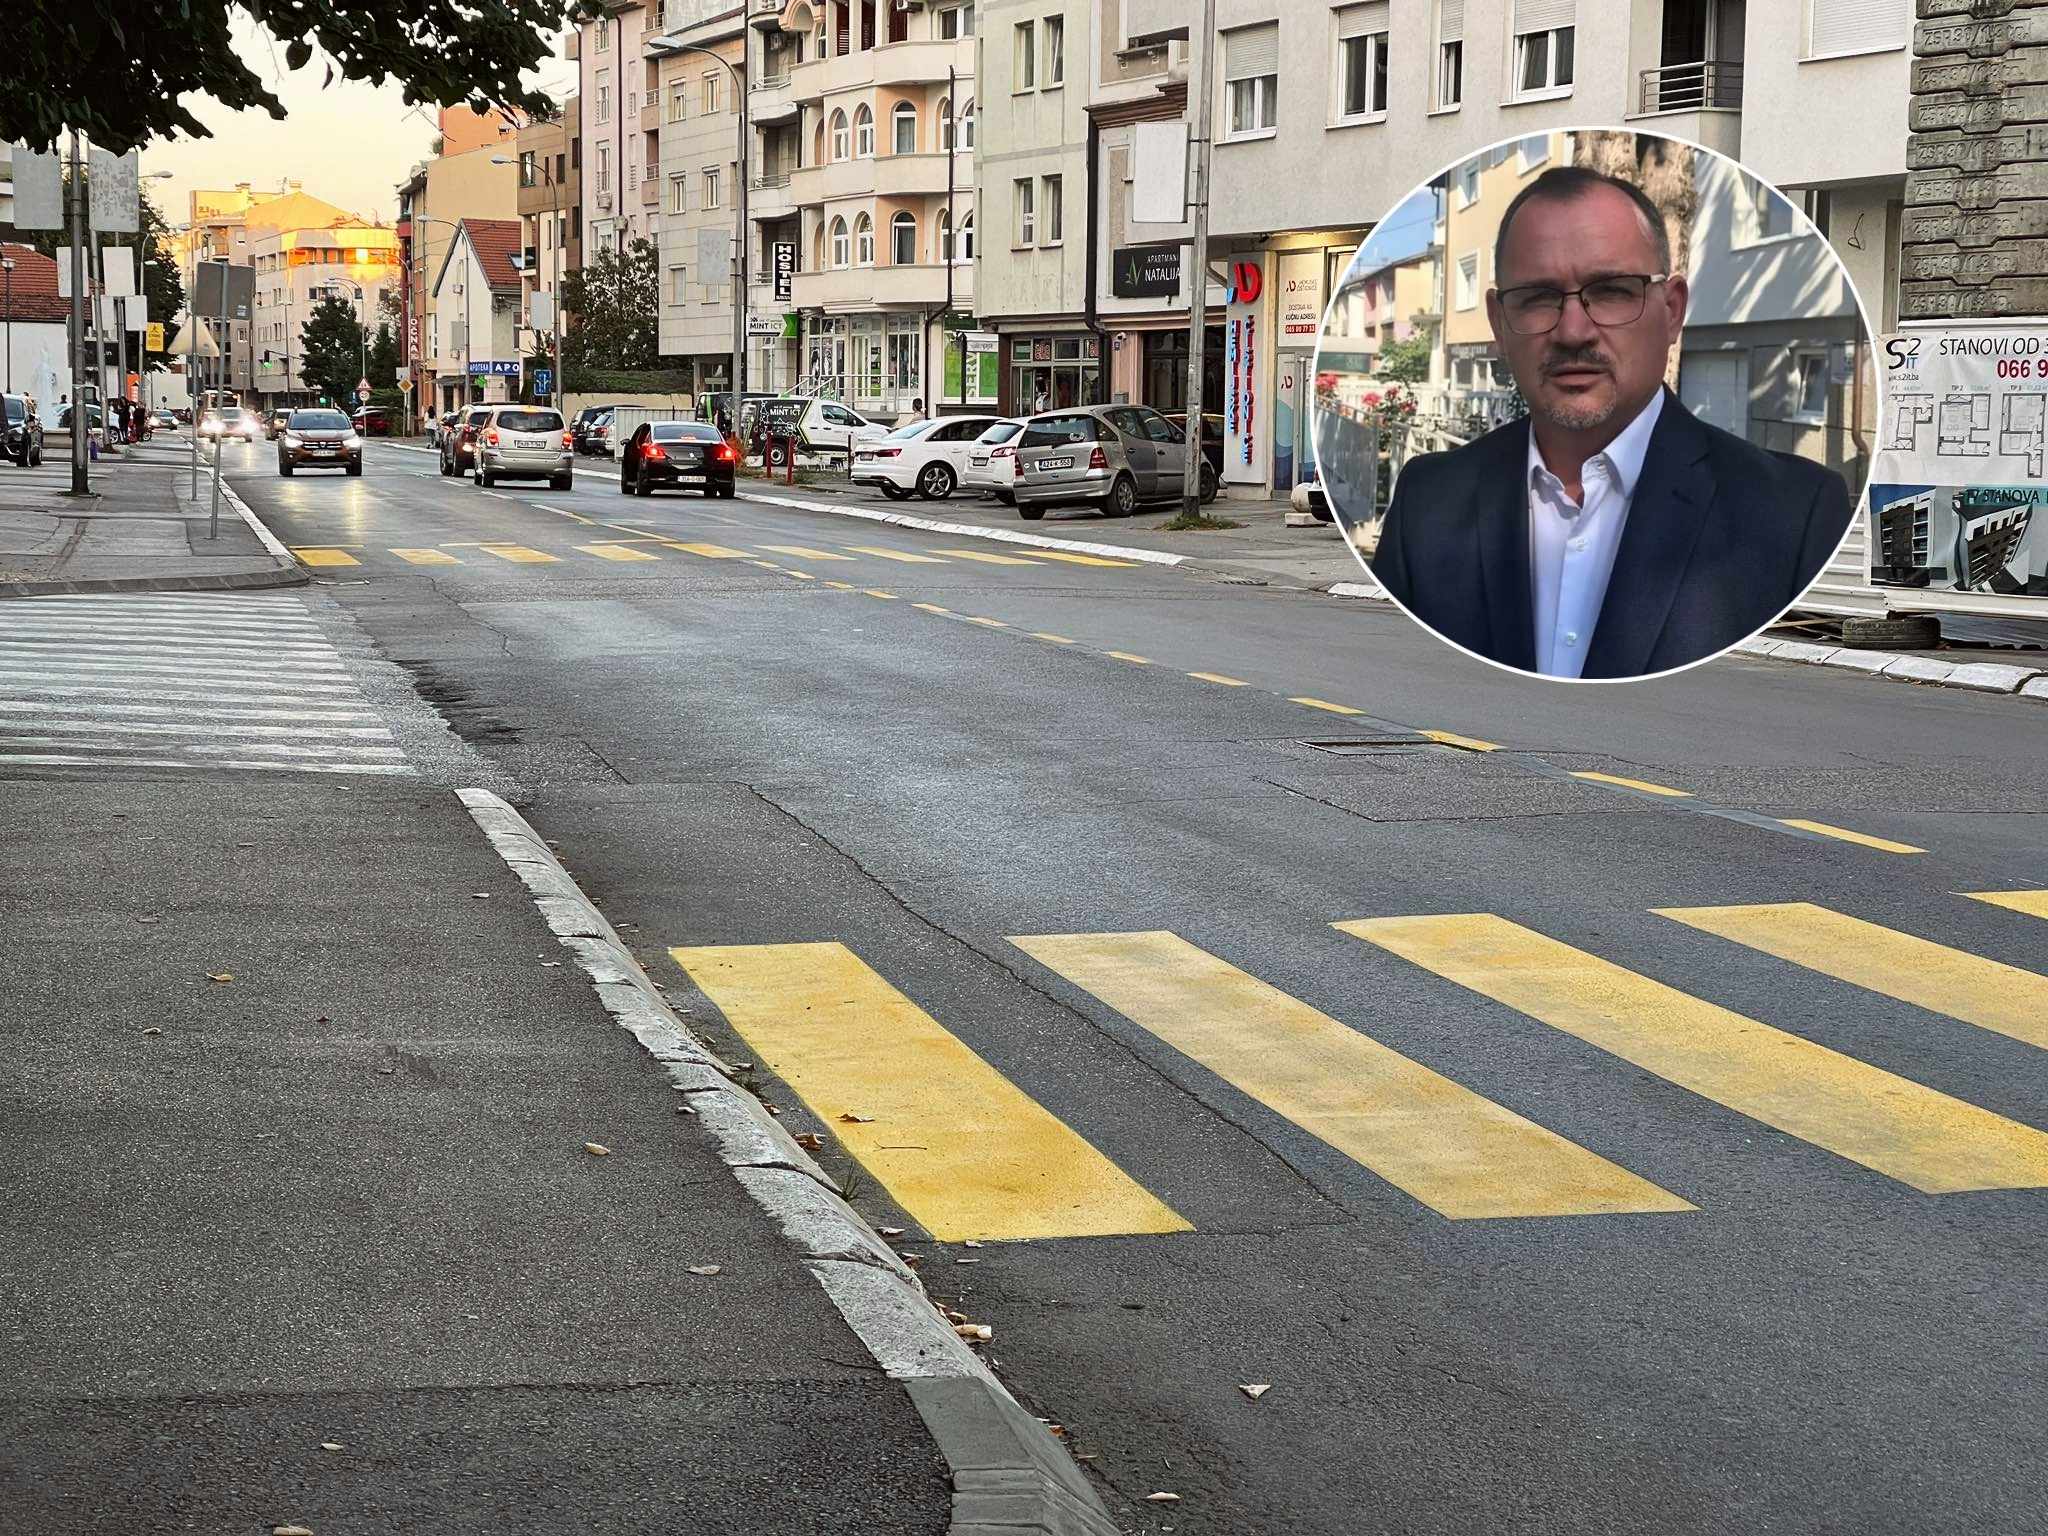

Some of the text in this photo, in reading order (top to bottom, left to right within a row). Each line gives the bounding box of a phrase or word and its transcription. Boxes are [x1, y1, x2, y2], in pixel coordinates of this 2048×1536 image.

[778, 245, 792, 294] HOSTEL
[1940, 338, 2039, 355] STANOVI OD
[1997, 359, 2031, 378] 066
